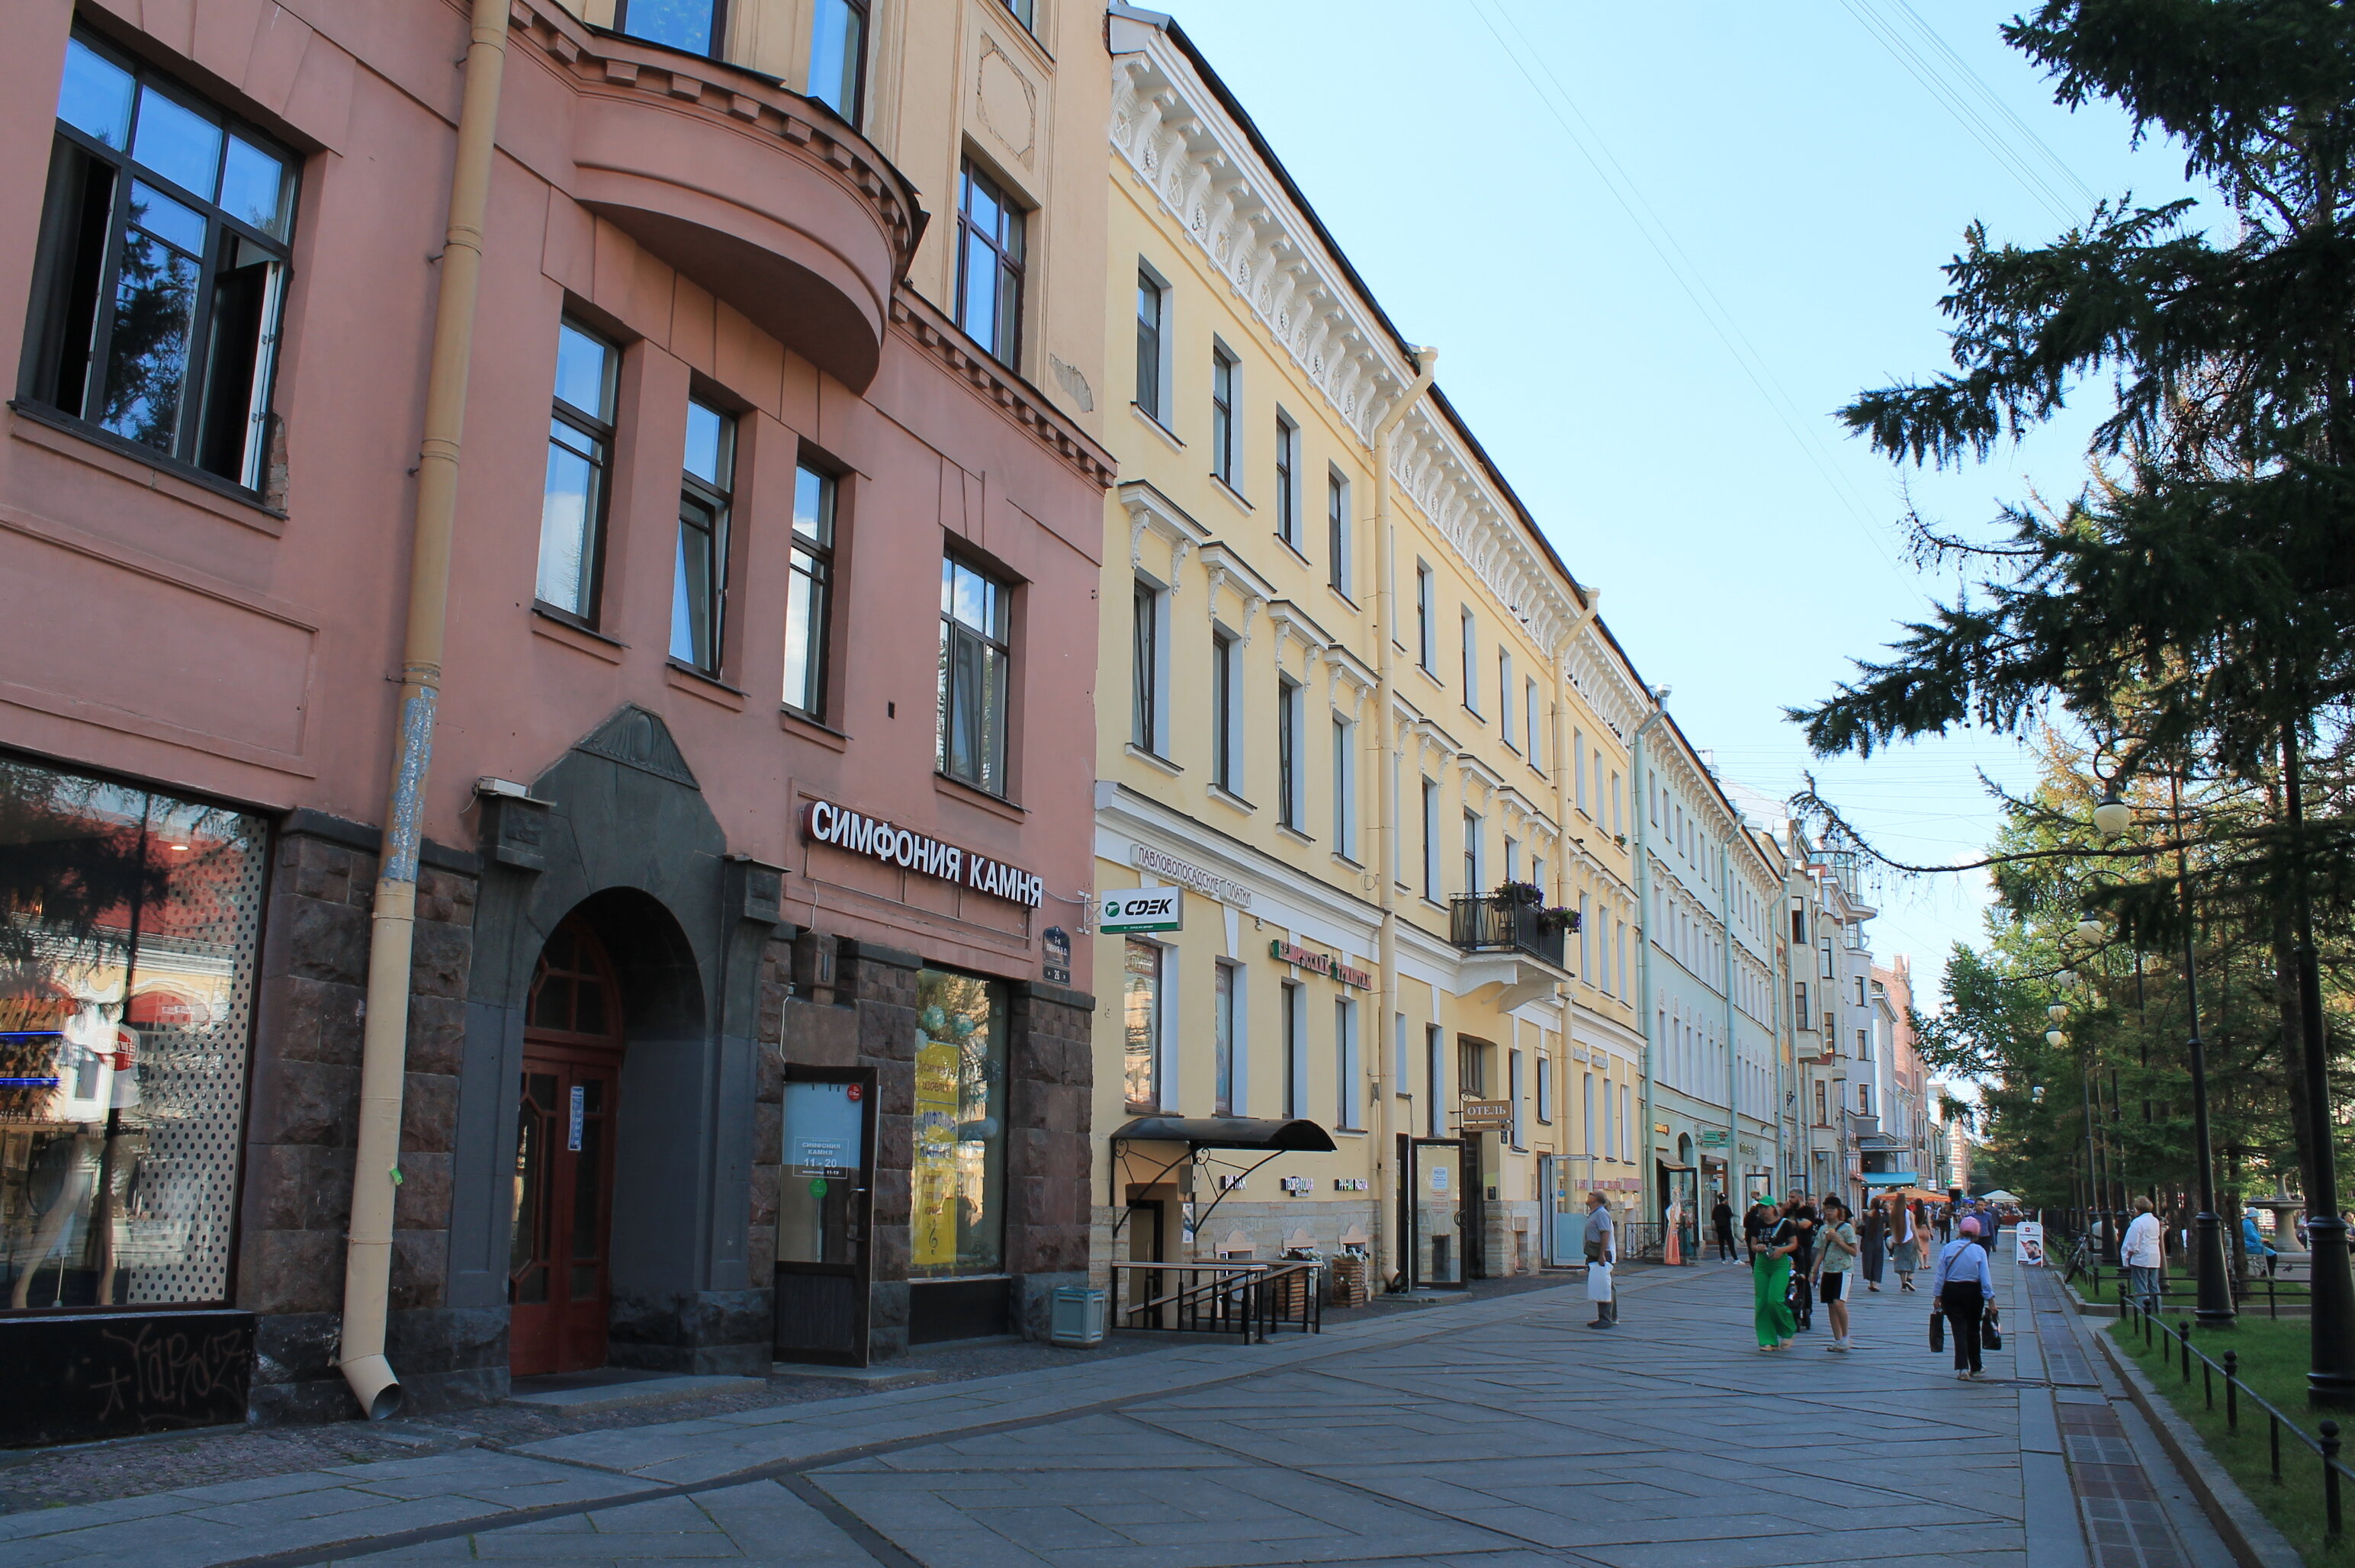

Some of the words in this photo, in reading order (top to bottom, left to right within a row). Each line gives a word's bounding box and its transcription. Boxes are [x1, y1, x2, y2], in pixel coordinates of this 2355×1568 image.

[811, 801, 961, 883] СИМФОНИЯ
[969, 854, 1043, 908] КАМНЯ
[1139, 847, 1219, 893] ПАВЛОВОПОСАДСКИЕ
[1226, 882, 1251, 904] ПЛАТКИ
[1125, 898, 1173, 915] CDEK
[1467, 1106, 1506, 1116] ОТЕЛЬ
